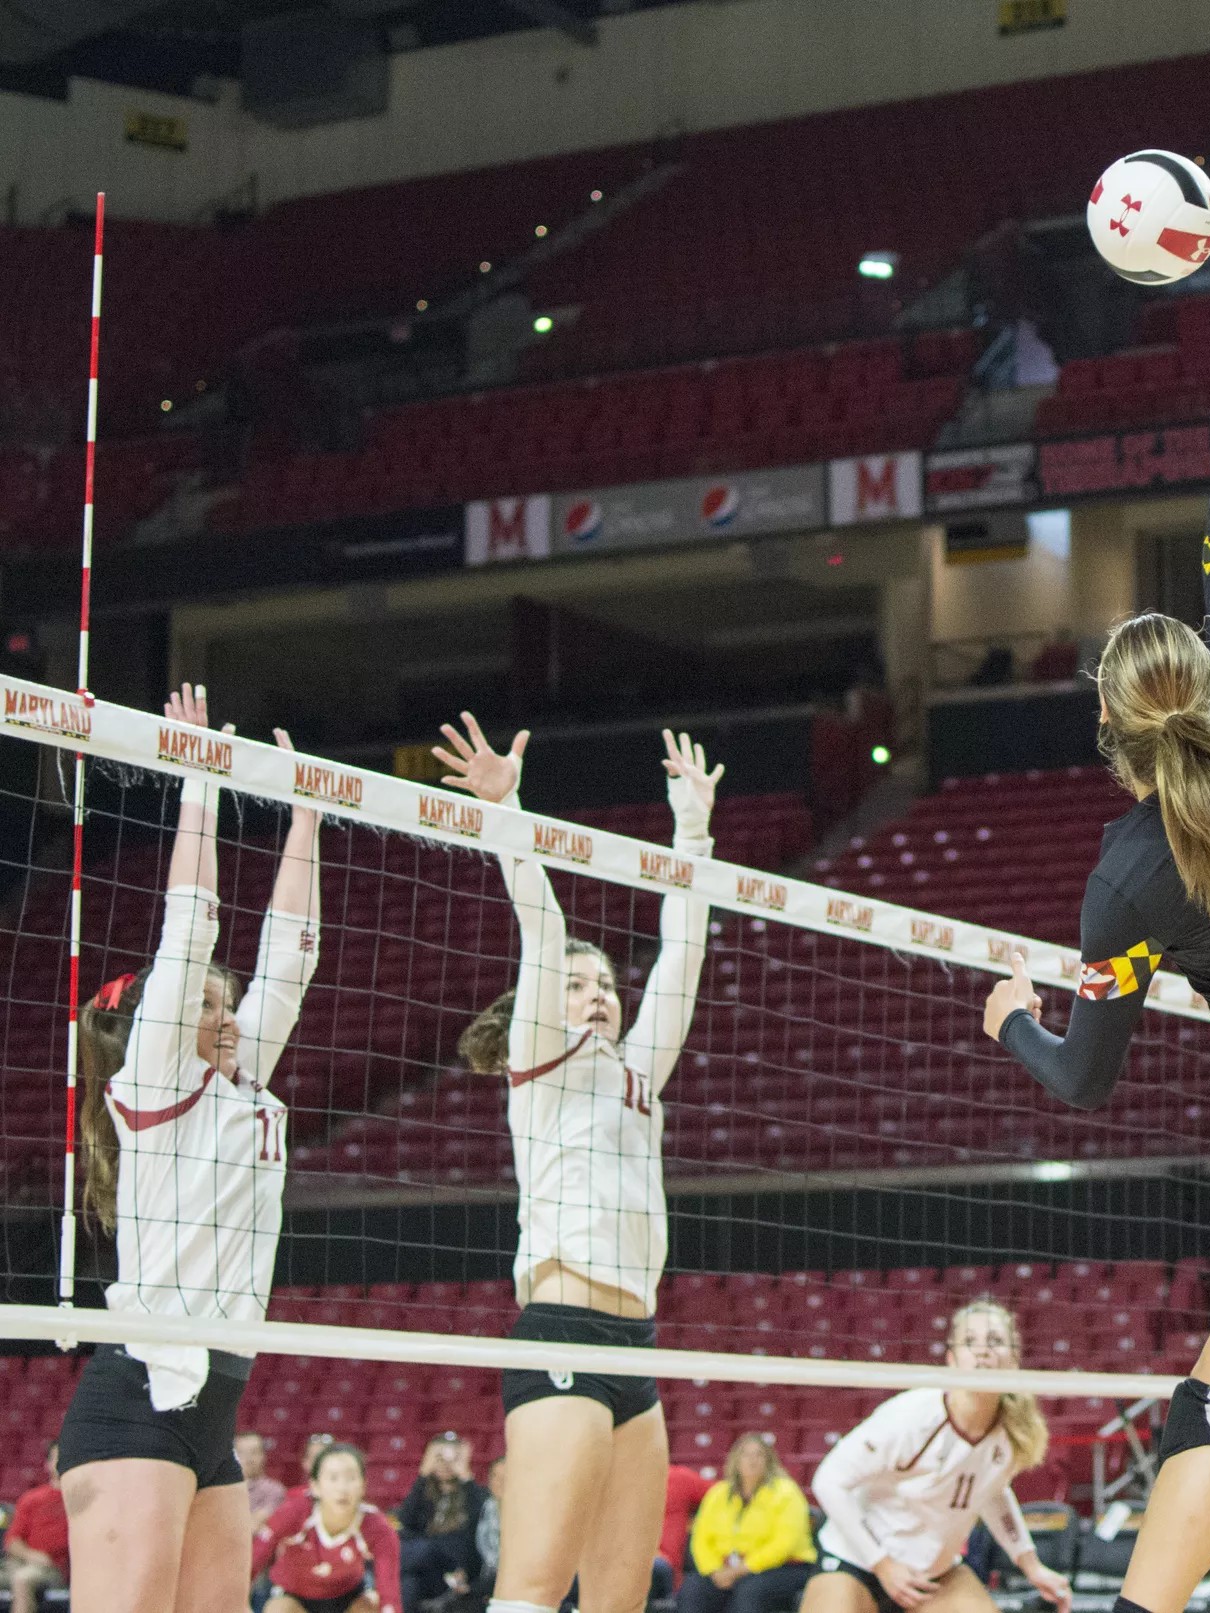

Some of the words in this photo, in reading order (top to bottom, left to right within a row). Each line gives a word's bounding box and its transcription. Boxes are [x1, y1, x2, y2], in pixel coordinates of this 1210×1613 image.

[858, 459, 898, 515] M
[489, 499, 525, 557] M
[4, 688, 92, 734] MARYLAND
[158, 726, 232, 770] MARYLAND
[294, 762, 363, 803] MARYLAND
[418, 794, 483, 833] MARYLAND
[534, 823, 593, 859] MARYLAND
[640, 850, 694, 885] MARYLAND
[736, 876, 787, 908] MARYLAND
[950, 1473, 976, 1509] 11
